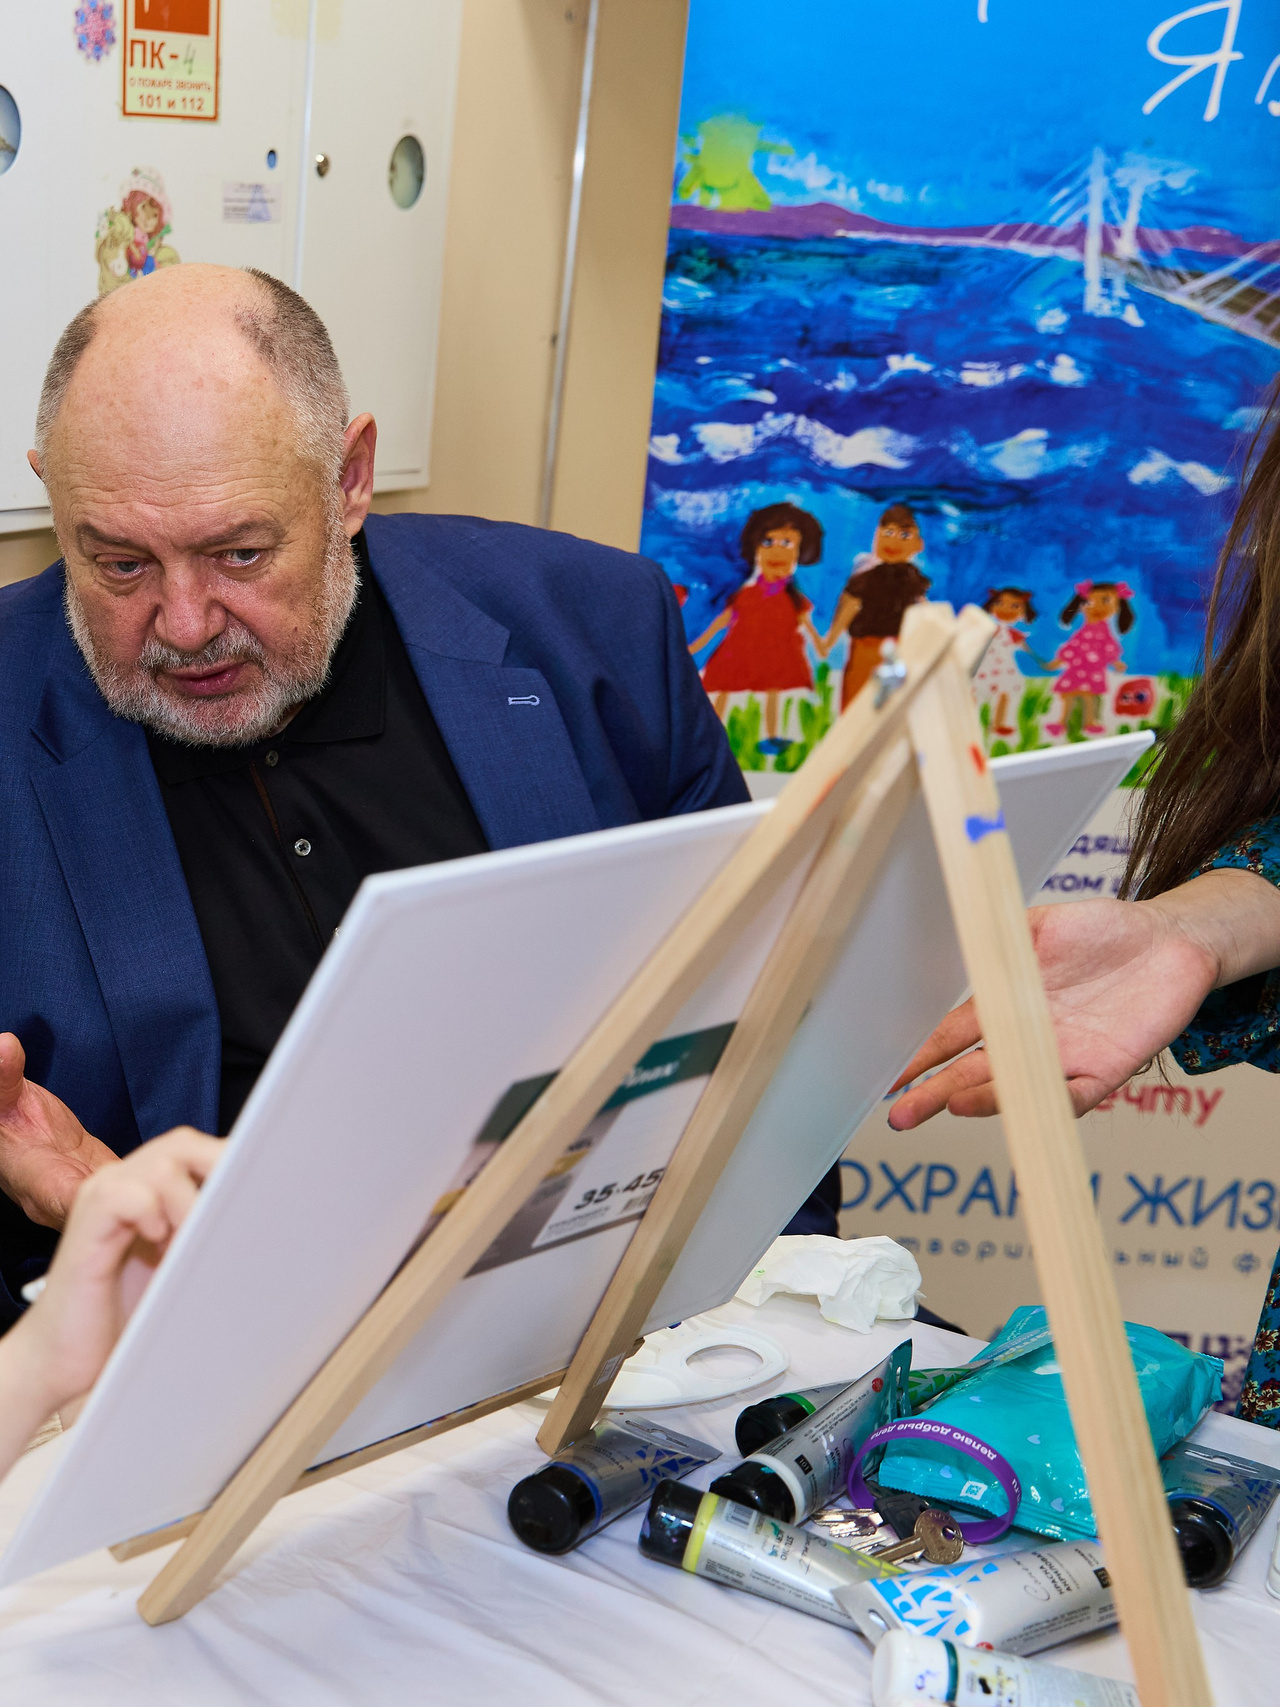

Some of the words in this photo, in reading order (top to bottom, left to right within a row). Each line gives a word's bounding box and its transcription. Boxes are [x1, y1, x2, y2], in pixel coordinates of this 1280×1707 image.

[138, 78, 173, 90] ПОЖАРЕ
[176, 80, 212, 92] ЗВОНИТЬ
[139, 94, 162, 109] 101
[182, 96, 204, 111] 112
[1120, 1171, 1280, 1232] ЖИЗ
[870, 1424, 897, 1440] дела
[897, 1421, 951, 1436] добрые
[952, 1431, 997, 1461] делаю
